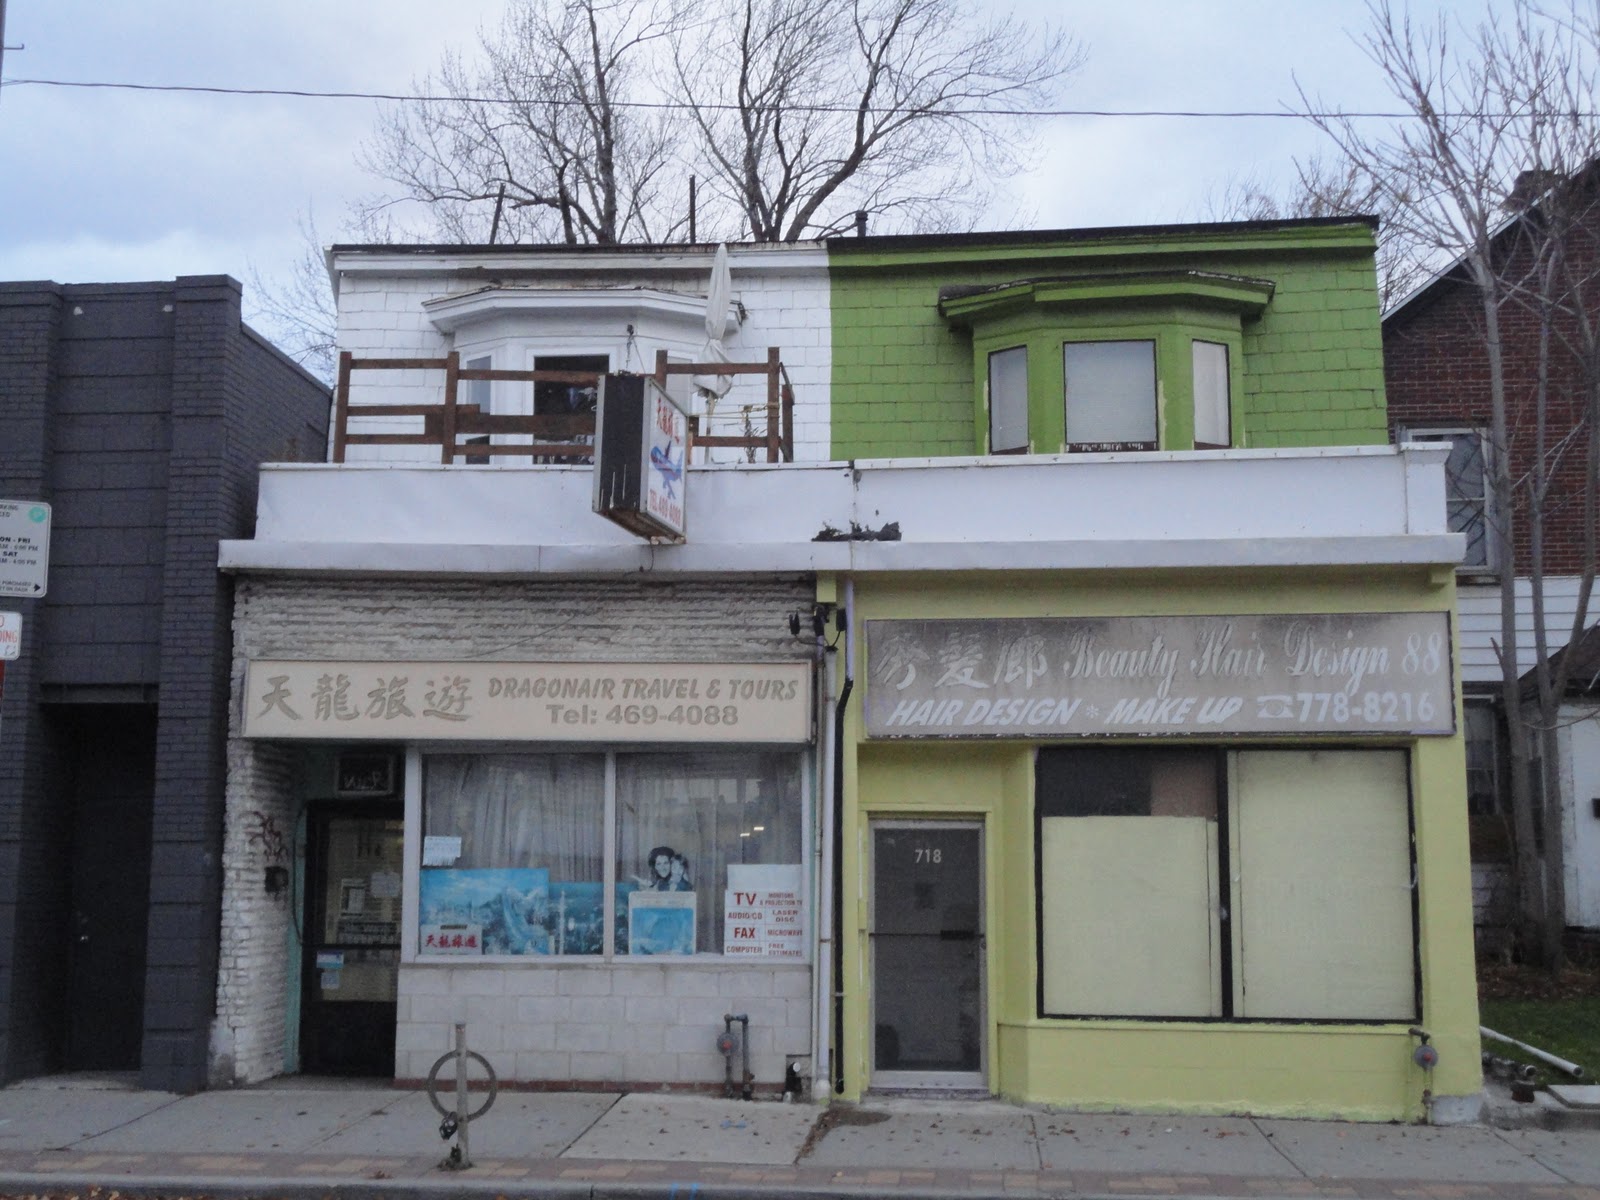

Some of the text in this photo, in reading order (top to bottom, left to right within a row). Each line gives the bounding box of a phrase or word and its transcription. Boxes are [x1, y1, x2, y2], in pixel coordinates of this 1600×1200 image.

[1063, 620, 1443, 699] Beauty Hair Design 88
[255, 673, 472, 722] 天龍旅遊
[488, 677, 799, 700] DRAGONAIR TRAVEL & TOURS
[546, 704, 739, 726] Tel: 469-4088
[886, 691, 1436, 726] HAIR DESIGN MAKE UP 778-8216
[914, 848, 942, 864] 718
[733, 892, 757, 905] TV
[734, 927, 756, 938] FAX
